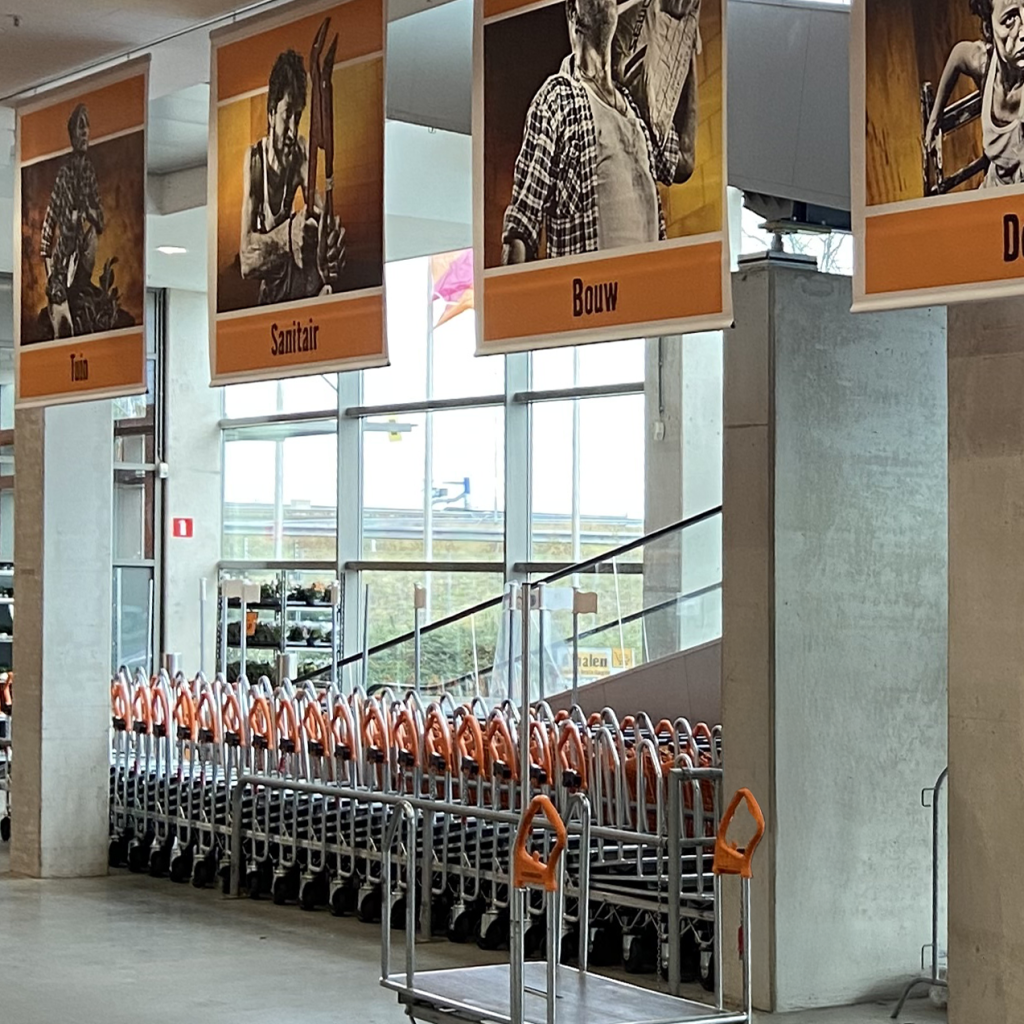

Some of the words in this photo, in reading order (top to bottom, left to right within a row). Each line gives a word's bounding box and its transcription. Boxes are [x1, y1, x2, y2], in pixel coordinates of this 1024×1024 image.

[573, 278, 618, 317] Bouw
[271, 318, 319, 356] Sanitair
[70, 353, 88, 382] Tuin
[178, 520, 187, 536] 1
